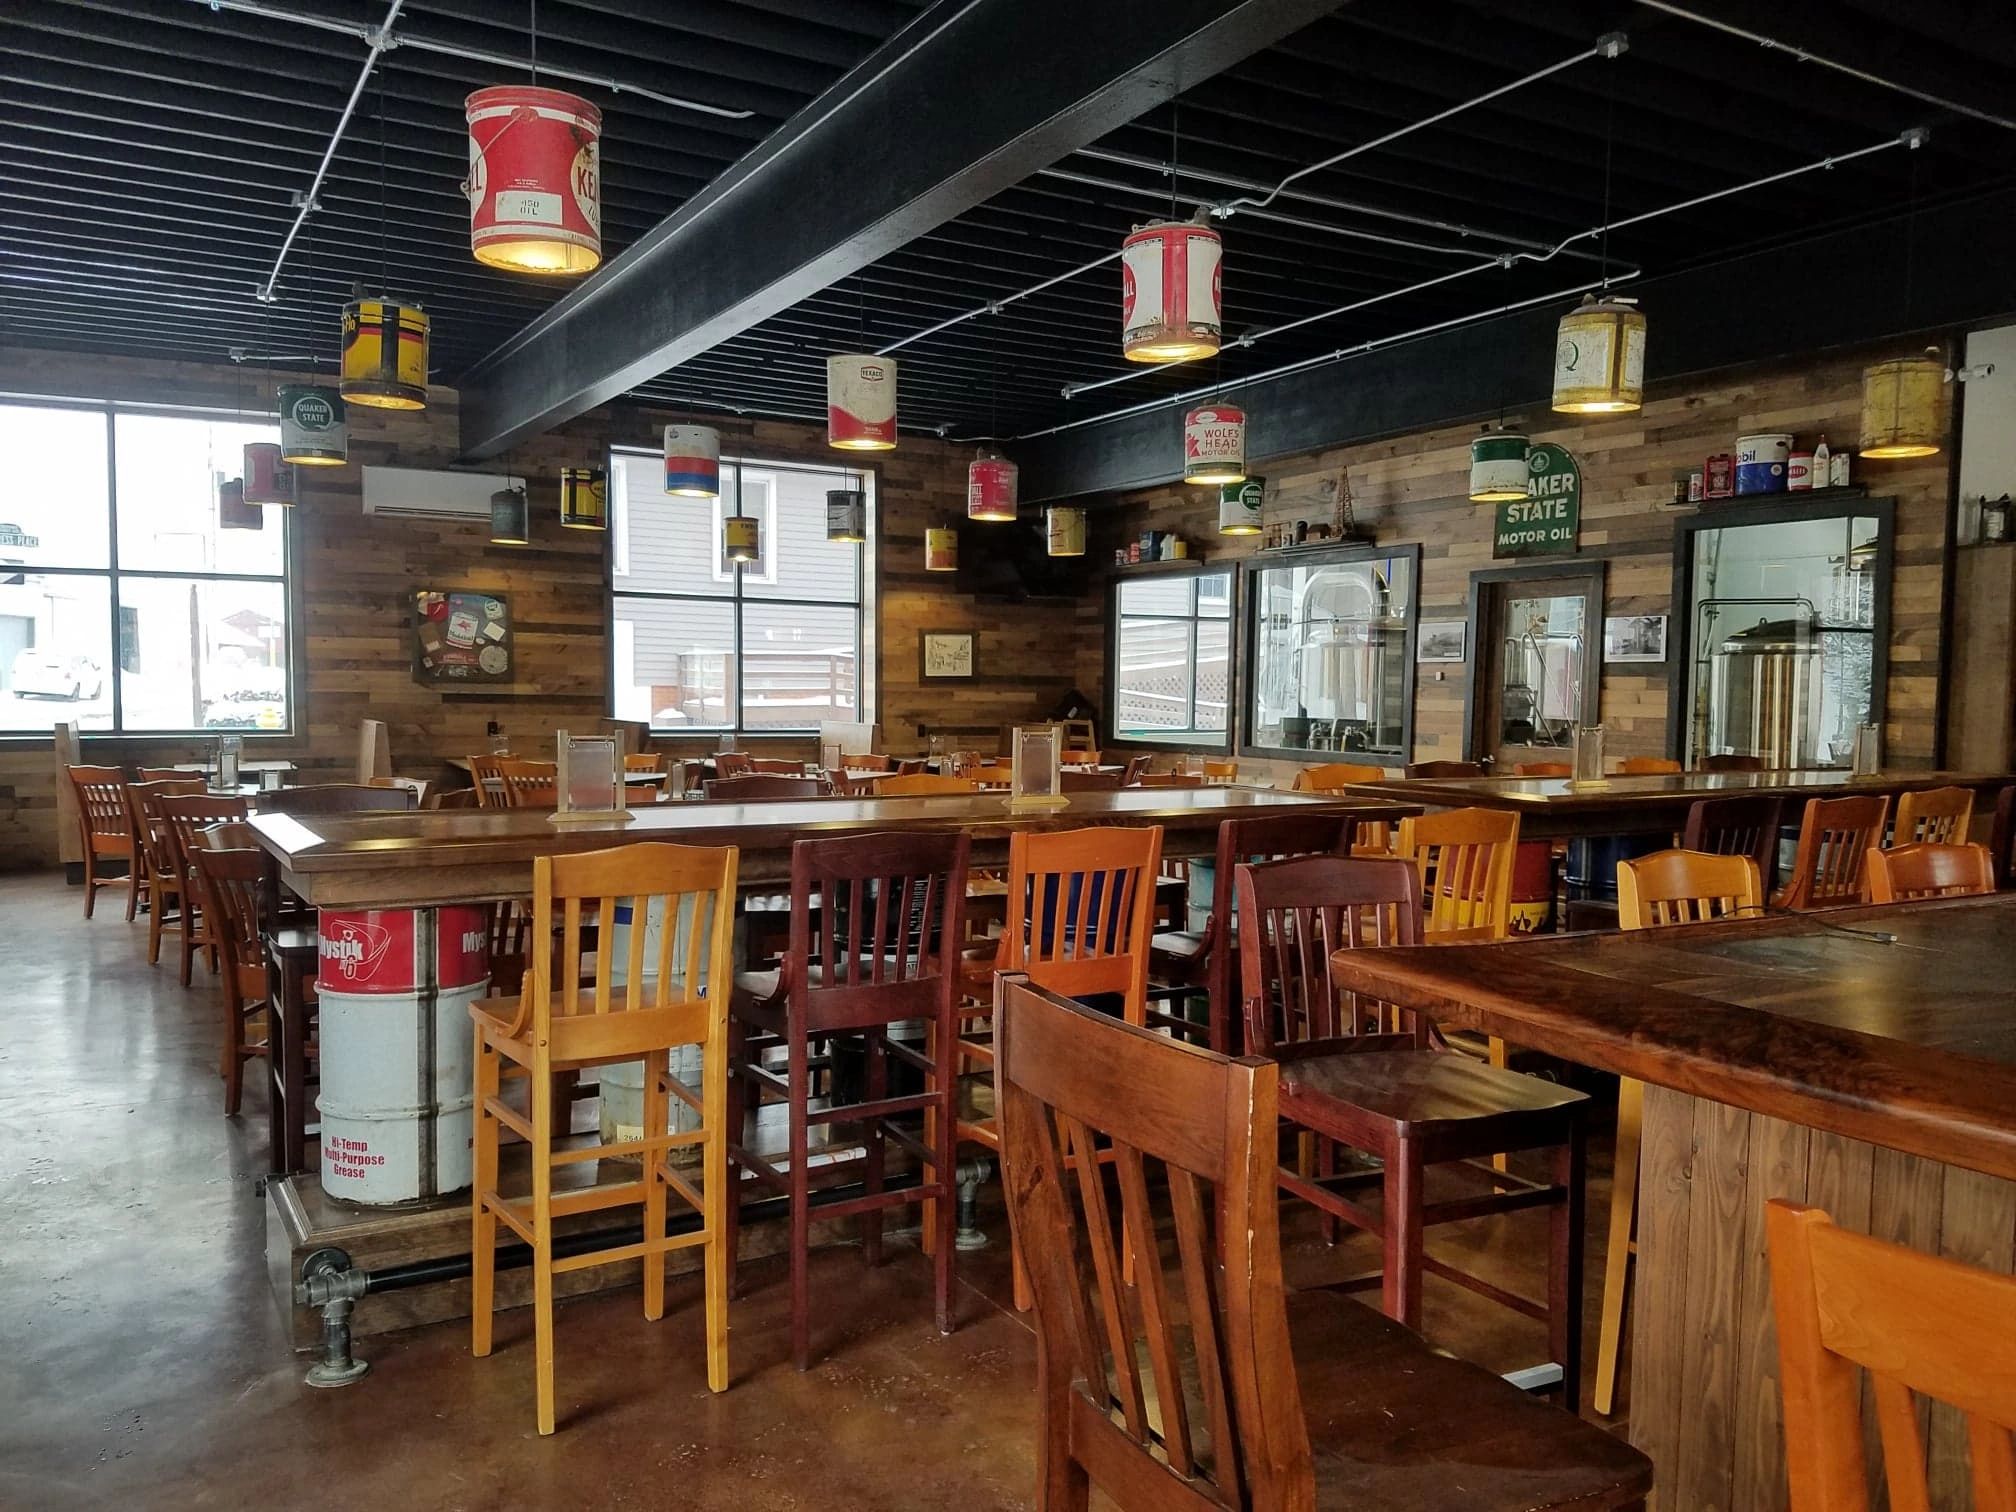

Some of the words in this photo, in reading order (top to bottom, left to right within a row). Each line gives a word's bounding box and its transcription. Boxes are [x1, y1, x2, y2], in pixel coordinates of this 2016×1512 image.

[298, 403, 328, 413] QUAKER
[302, 413, 325, 422] STATE
[1205, 438, 1238, 450] HEAD
[1201, 449, 1228, 457] MOTOR
[1528, 472, 1575, 497] AKER
[1506, 498, 1568, 523] STATE
[1498, 529, 1546, 546] MOTOR
[1550, 527, 1572, 540] OIL
[331, 1135, 368, 1152] Hi-Temp
[324, 1146, 385, 1166] Multi-Purpose
[333, 1163, 365, 1179] Grease
